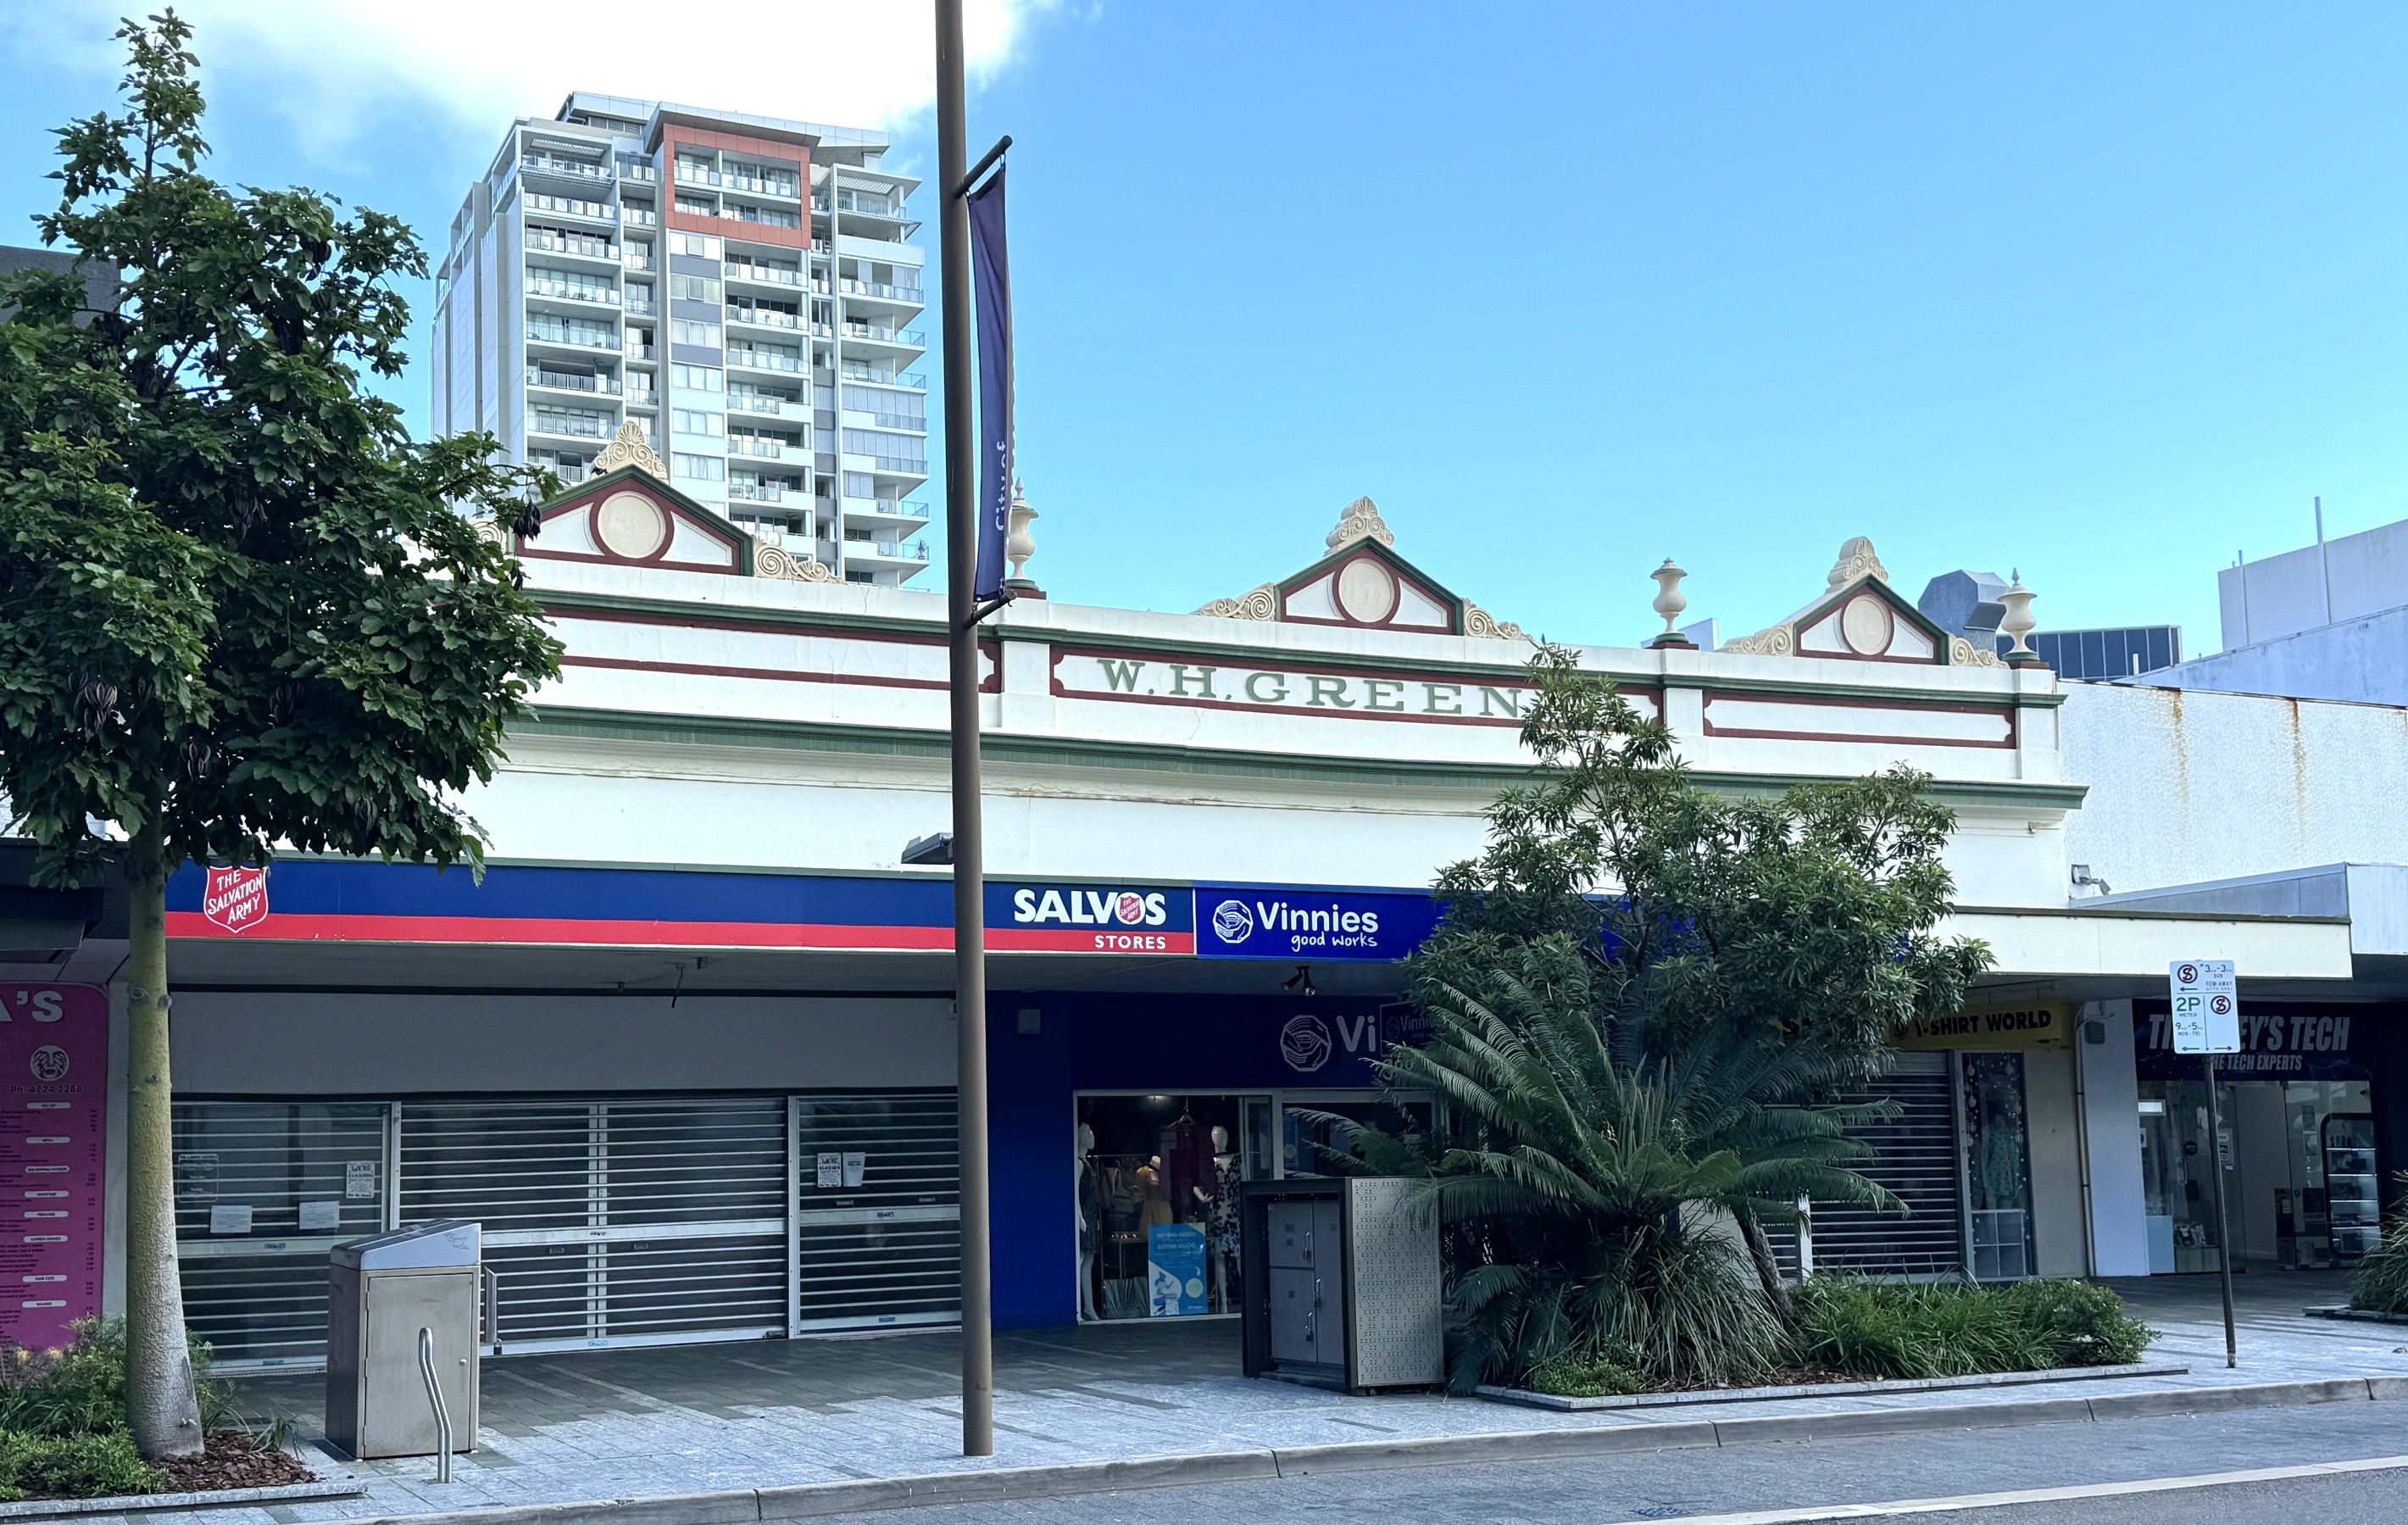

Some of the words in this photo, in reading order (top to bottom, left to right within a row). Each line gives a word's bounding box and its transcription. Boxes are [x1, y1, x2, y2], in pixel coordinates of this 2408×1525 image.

[217, 870, 242, 891] THE
[208, 872, 262, 915] SALVATION
[227, 893, 260, 925] ARMY
[1014, 888, 1166, 926] SALVOS
[1256, 901, 1378, 933] Vinnies
[1094, 935, 1166, 949] STORES
[1291, 931, 1326, 952] good
[1332, 932, 1377, 947] works
[2176, 997, 2200, 1011] 2P
[1400, 1015, 1436, 1032] Vinnie
[1986, 1010, 2051, 1032] WORLD
[2290, 1016, 2350, 1051] TECH
[2227, 1055, 2255, 1070] TECH
[2256, 1055, 2303, 1071] EXPERTS
